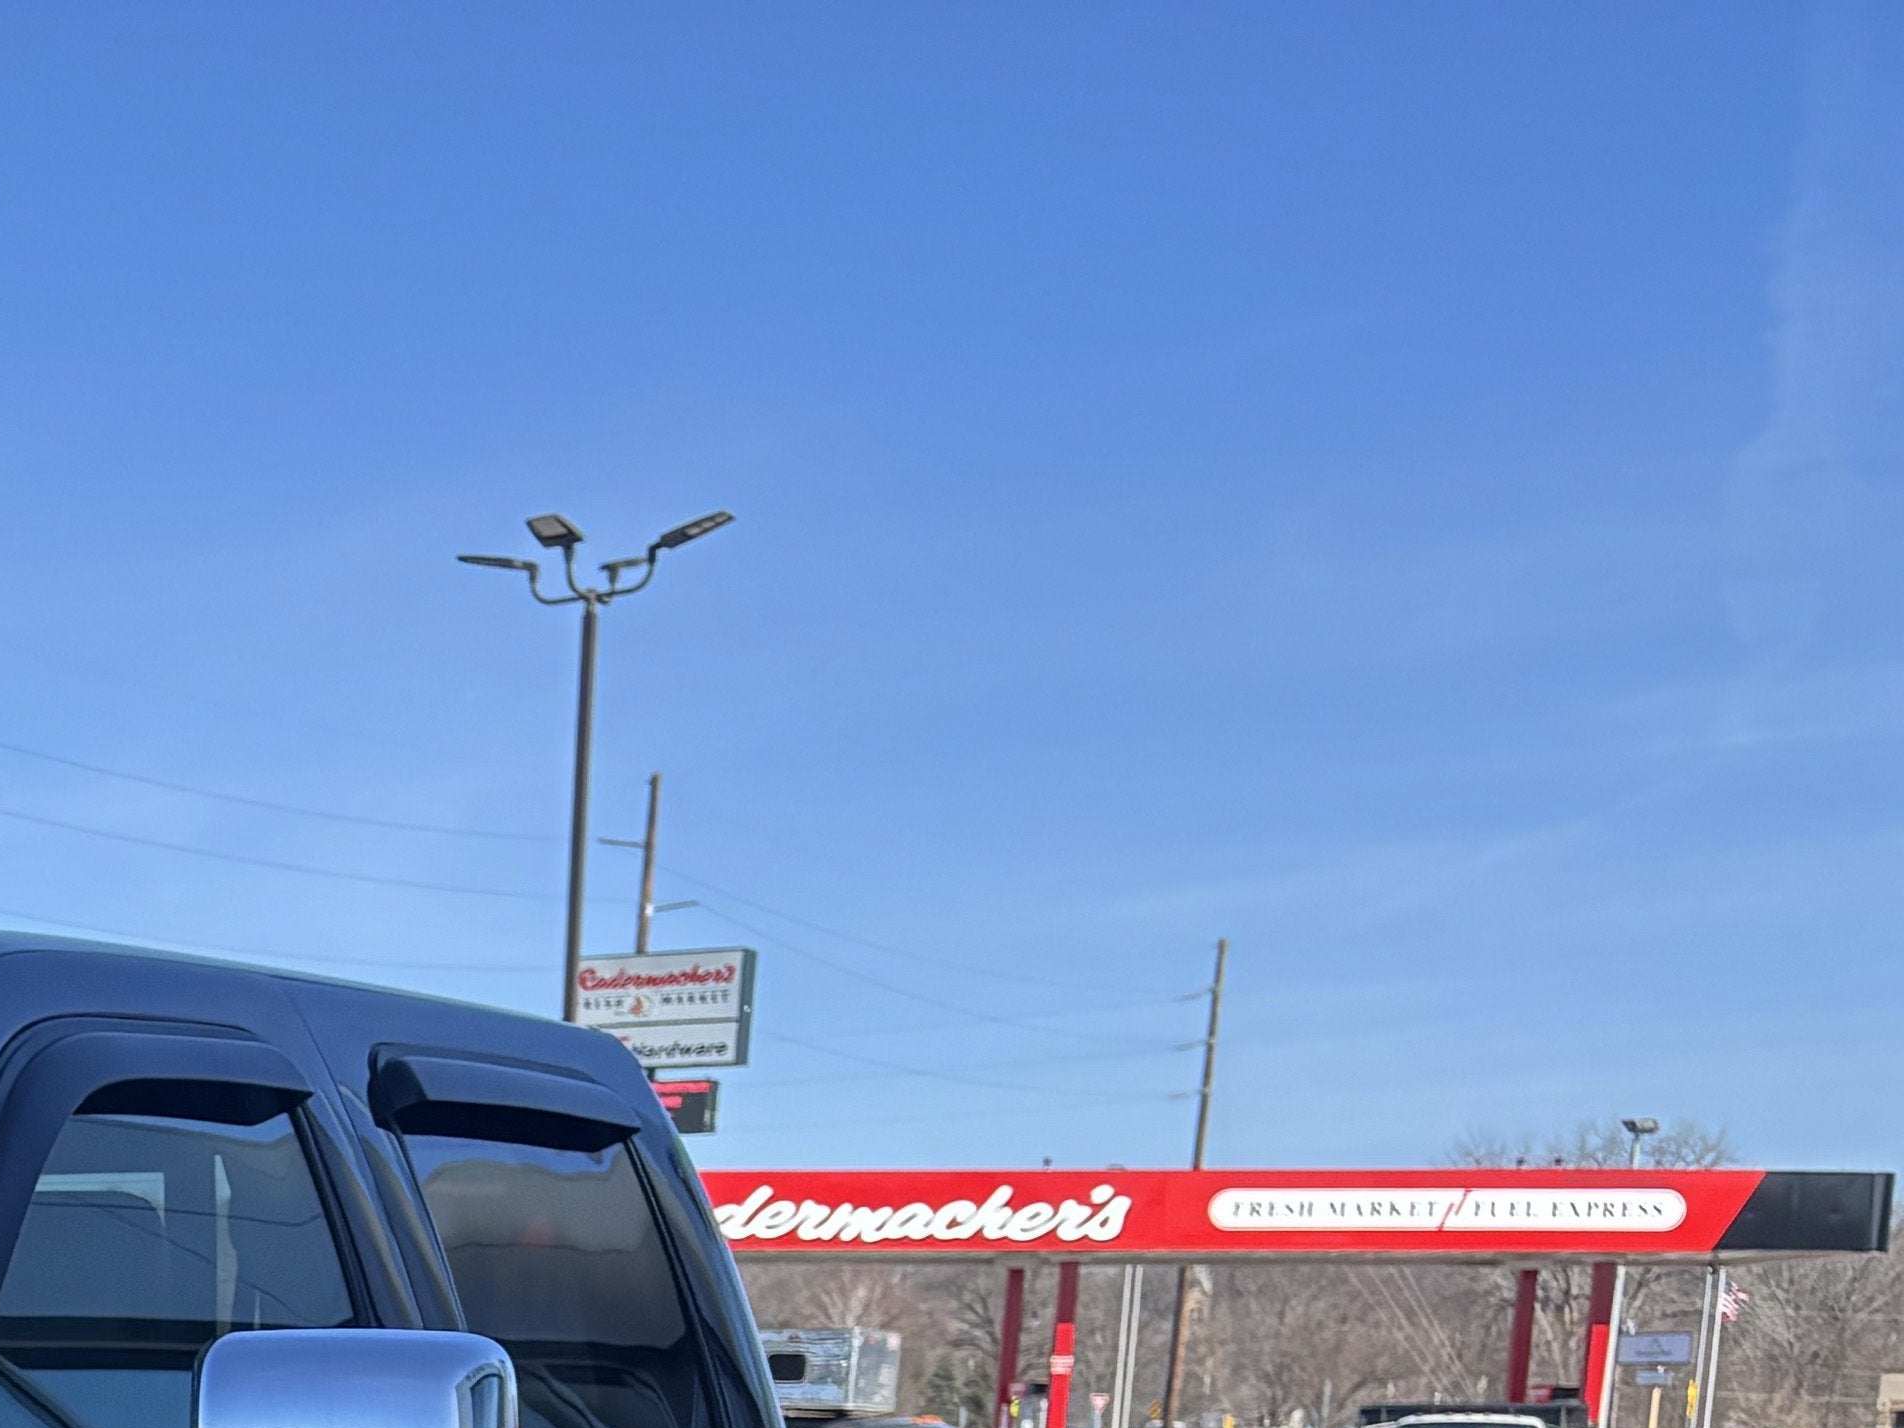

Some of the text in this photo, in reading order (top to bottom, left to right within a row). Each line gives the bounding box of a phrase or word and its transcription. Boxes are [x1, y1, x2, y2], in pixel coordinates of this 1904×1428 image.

[715, 1184, 1132, 1243] dermacher's
[1232, 1201, 1664, 1217] FRESH MARKET FUEL EXPRESS
